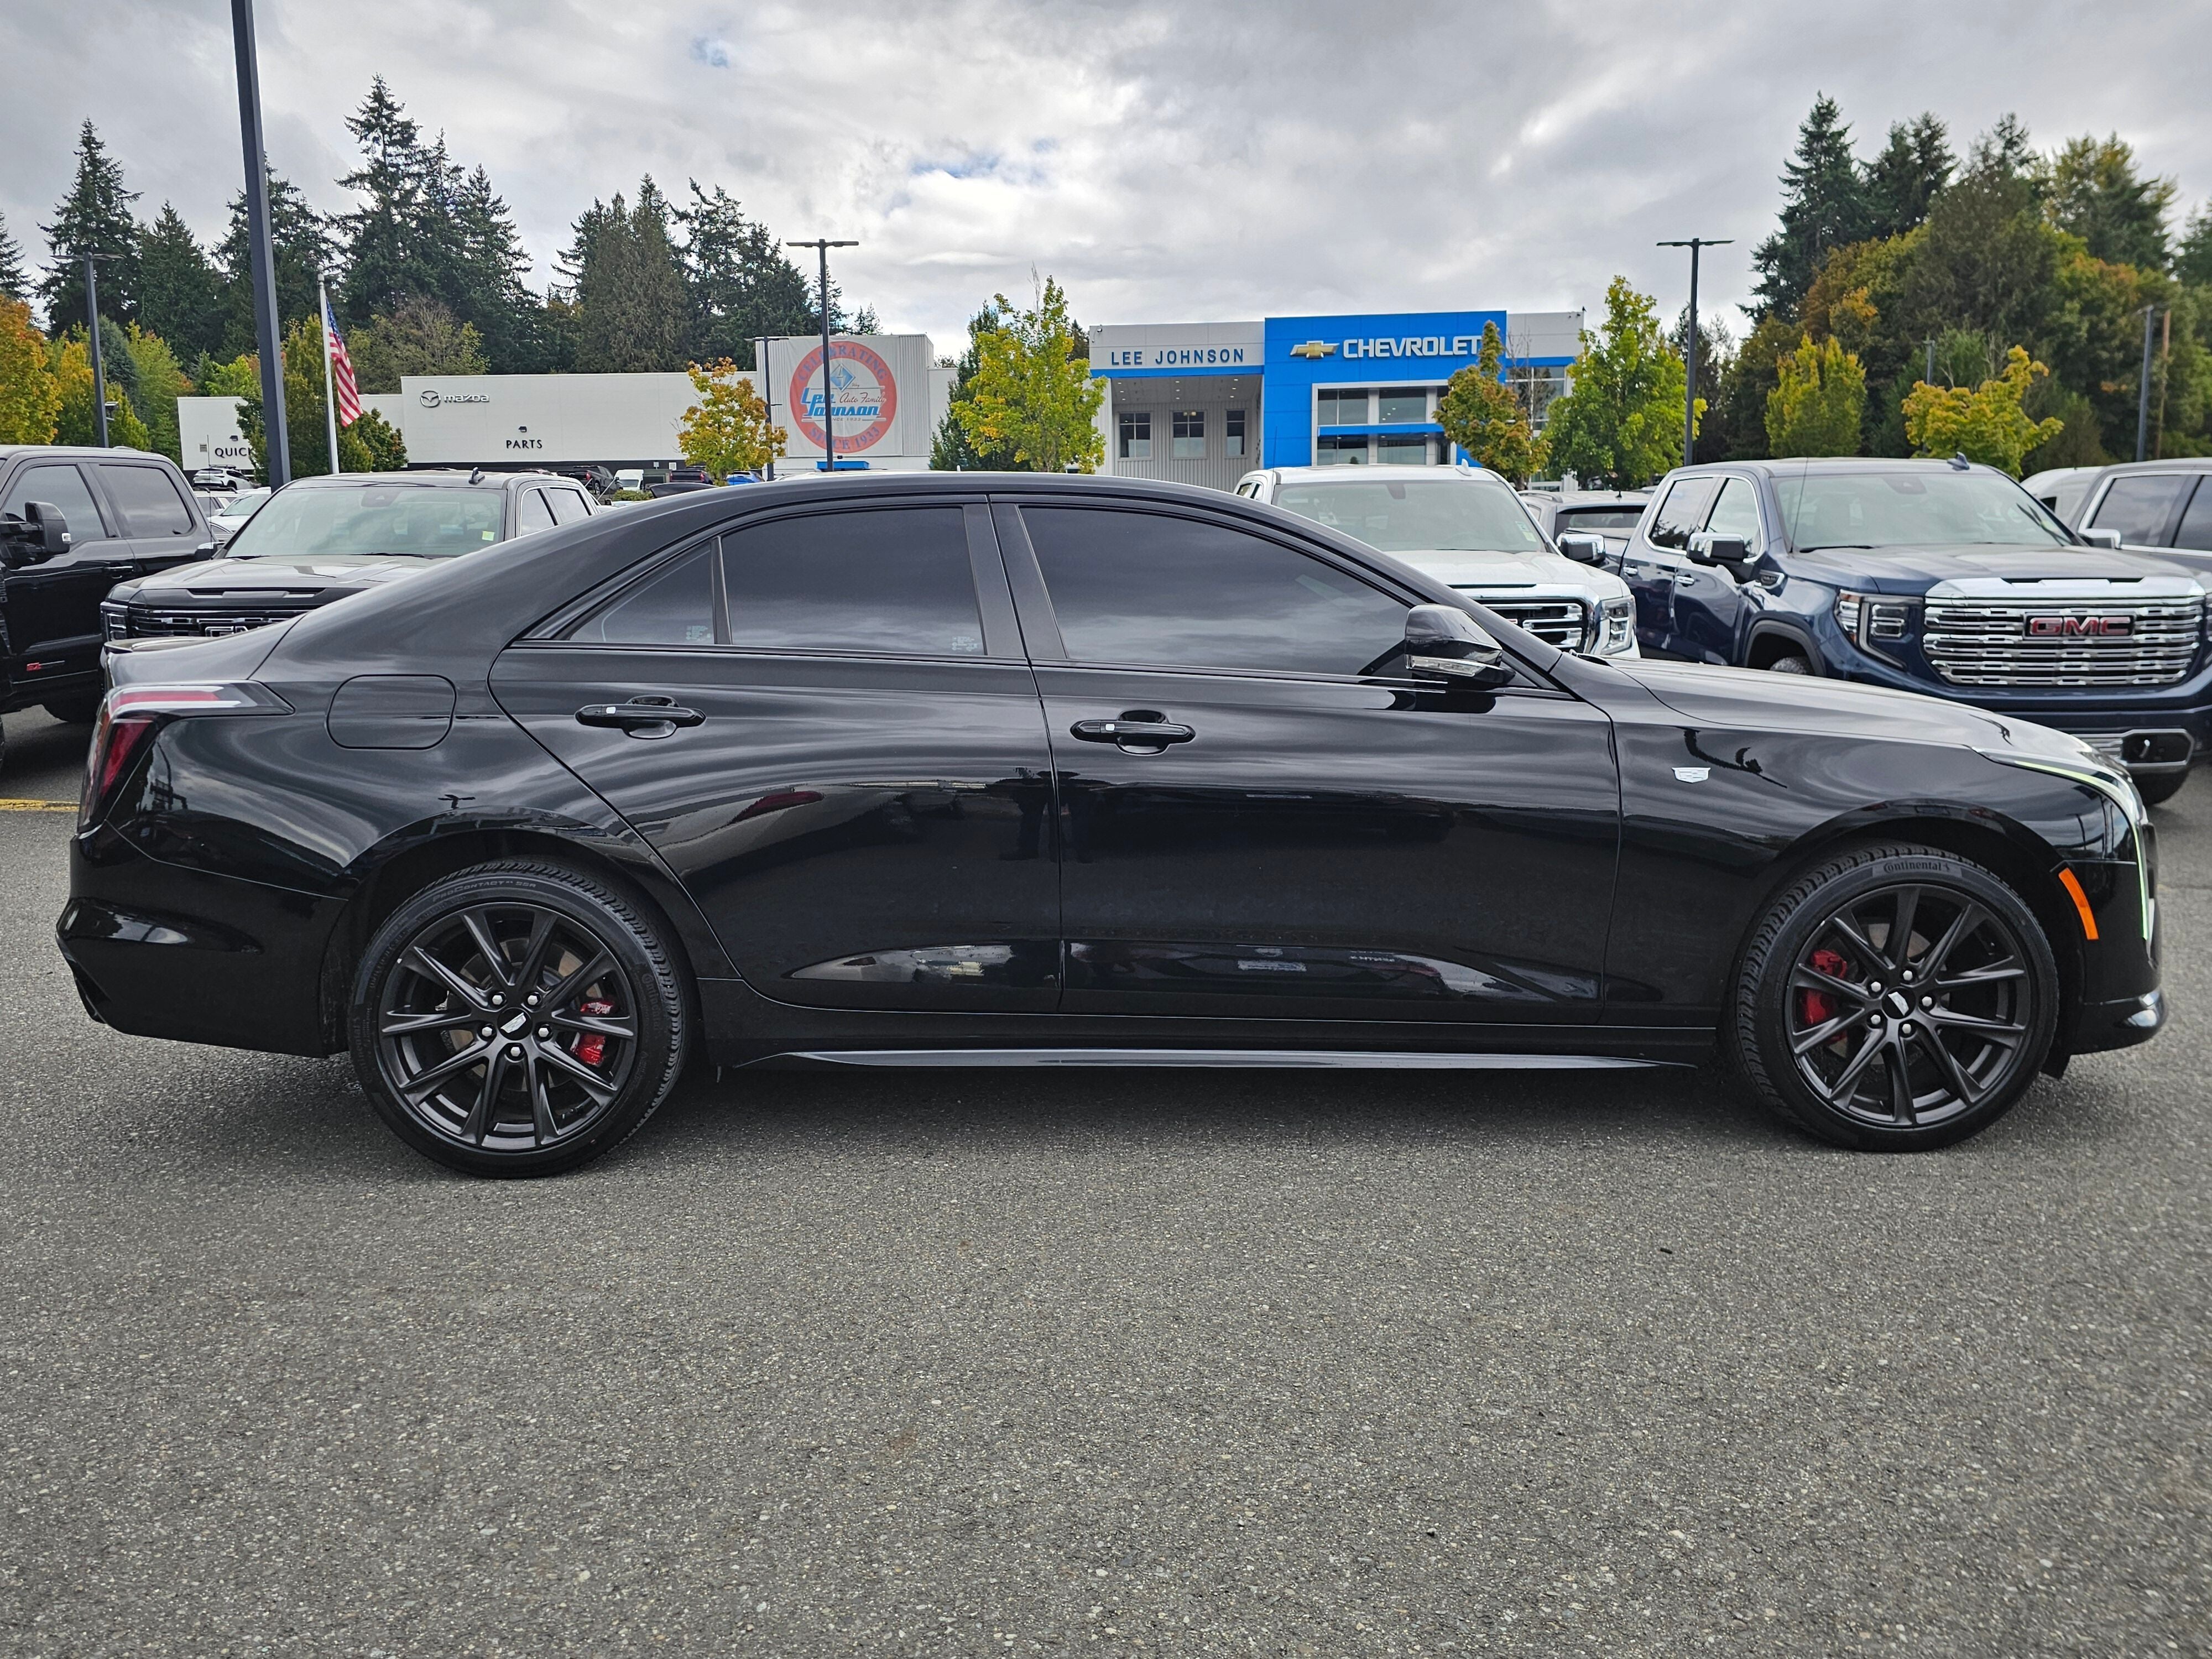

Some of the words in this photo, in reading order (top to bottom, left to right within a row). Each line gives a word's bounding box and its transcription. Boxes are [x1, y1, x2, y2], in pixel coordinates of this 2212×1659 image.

[1343, 335, 1482, 358] CHEVROLET
[1111, 351, 1142, 366] LEE
[1155, 348, 1244, 364] JOHNSON
[839, 392, 858, 403] Auto
[860, 392, 886, 406] Family
[506, 440, 542, 449] PARTS
[855, 426, 880, 448] 1933
[2030, 616, 2130, 635] GMC
[1883, 861, 1942, 873] Continental
